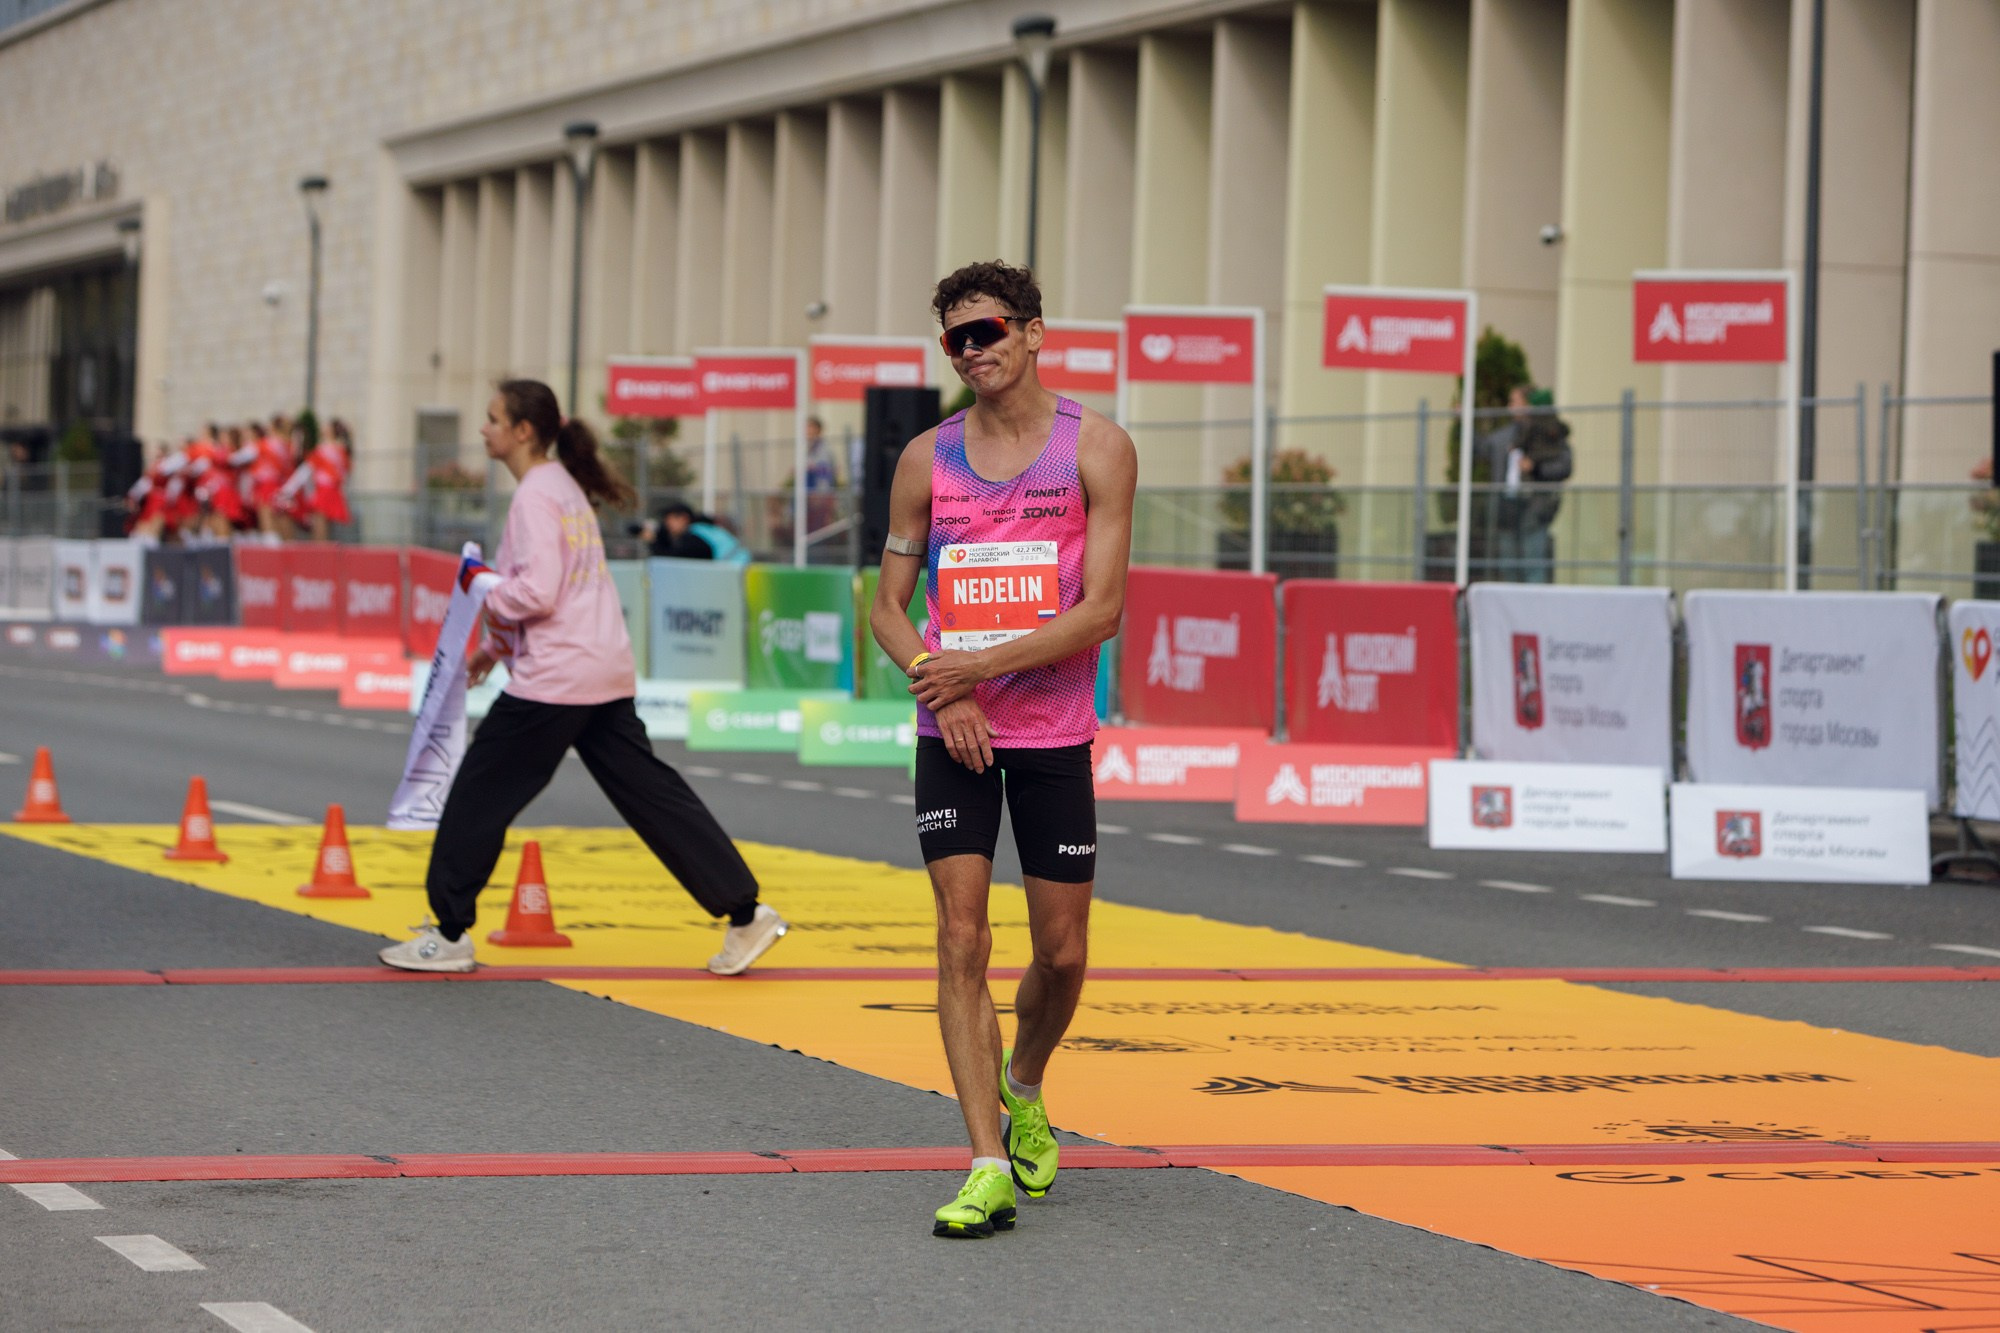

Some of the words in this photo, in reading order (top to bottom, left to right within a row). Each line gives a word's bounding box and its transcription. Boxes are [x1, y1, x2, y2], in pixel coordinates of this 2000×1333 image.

[1025, 487, 1068, 498] FONBET
[983, 508, 1016, 516] lamoda
[1020, 506, 1068, 519] SONU
[993, 516, 1015, 524] sport
[953, 576, 1043, 605] NEDELIN
[995, 614, 1000, 623] 1
[944, 819, 957, 829] GT
[1352, 1072, 1856, 1085] МОСКОВСКИЙ
[1390, 1084, 1633, 1094] СПОРТ
[1707, 1168, 2000, 1181] СБЕР
